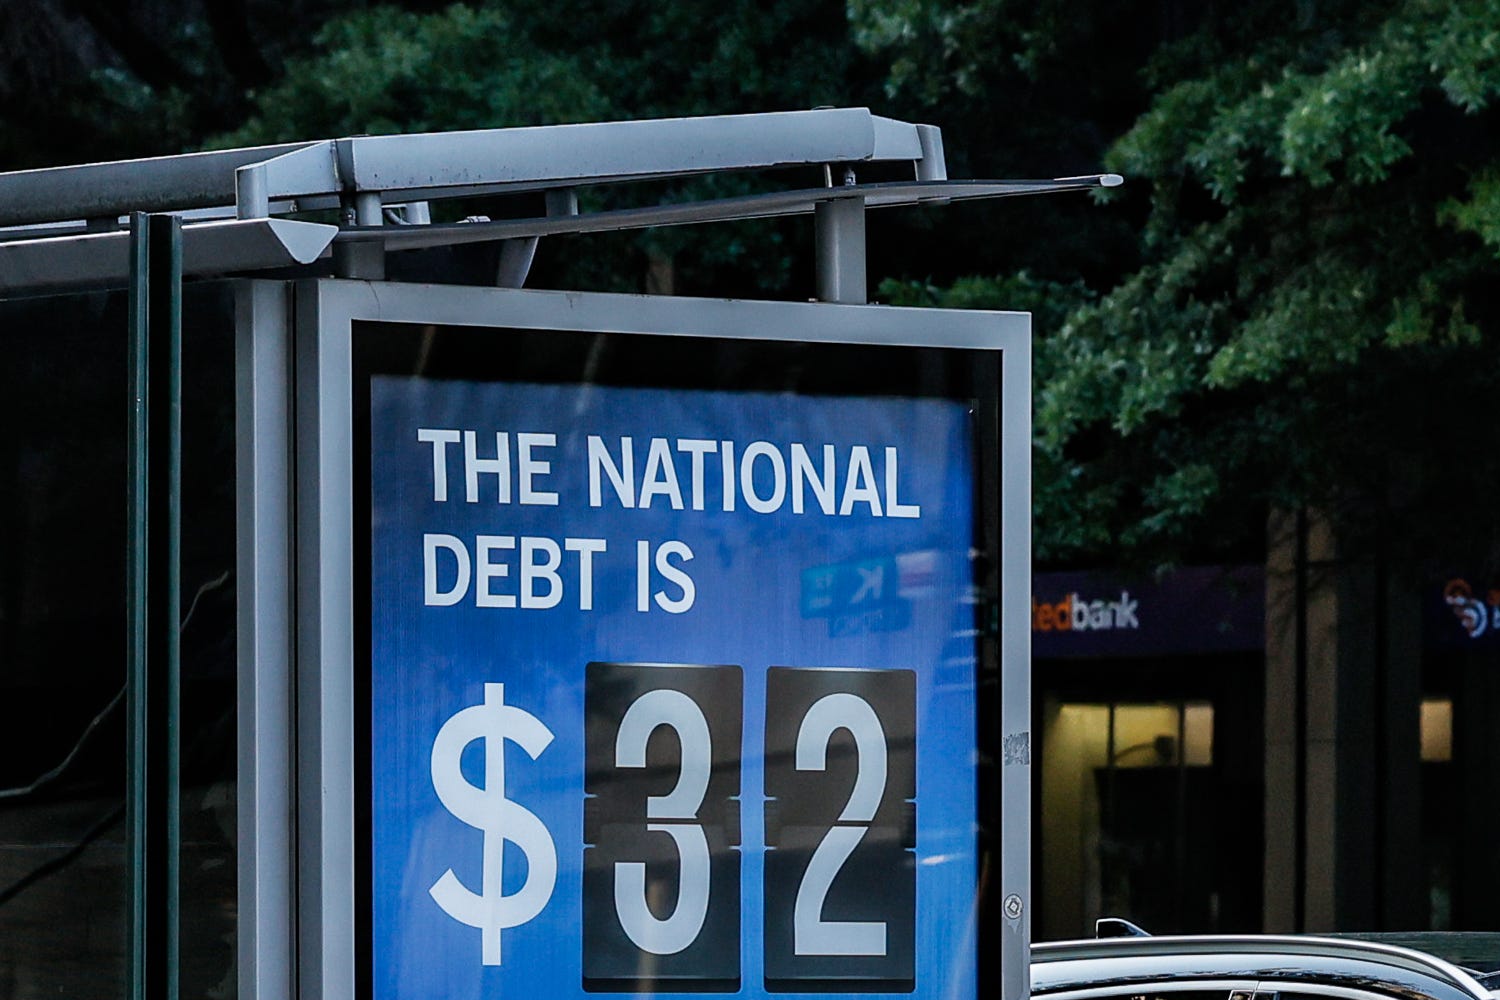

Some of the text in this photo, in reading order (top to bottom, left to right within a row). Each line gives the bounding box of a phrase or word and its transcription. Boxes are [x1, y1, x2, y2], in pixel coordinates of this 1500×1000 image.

[417, 428, 921, 519] THE NATIONAL
[423, 533, 696, 614] DEBT IS
